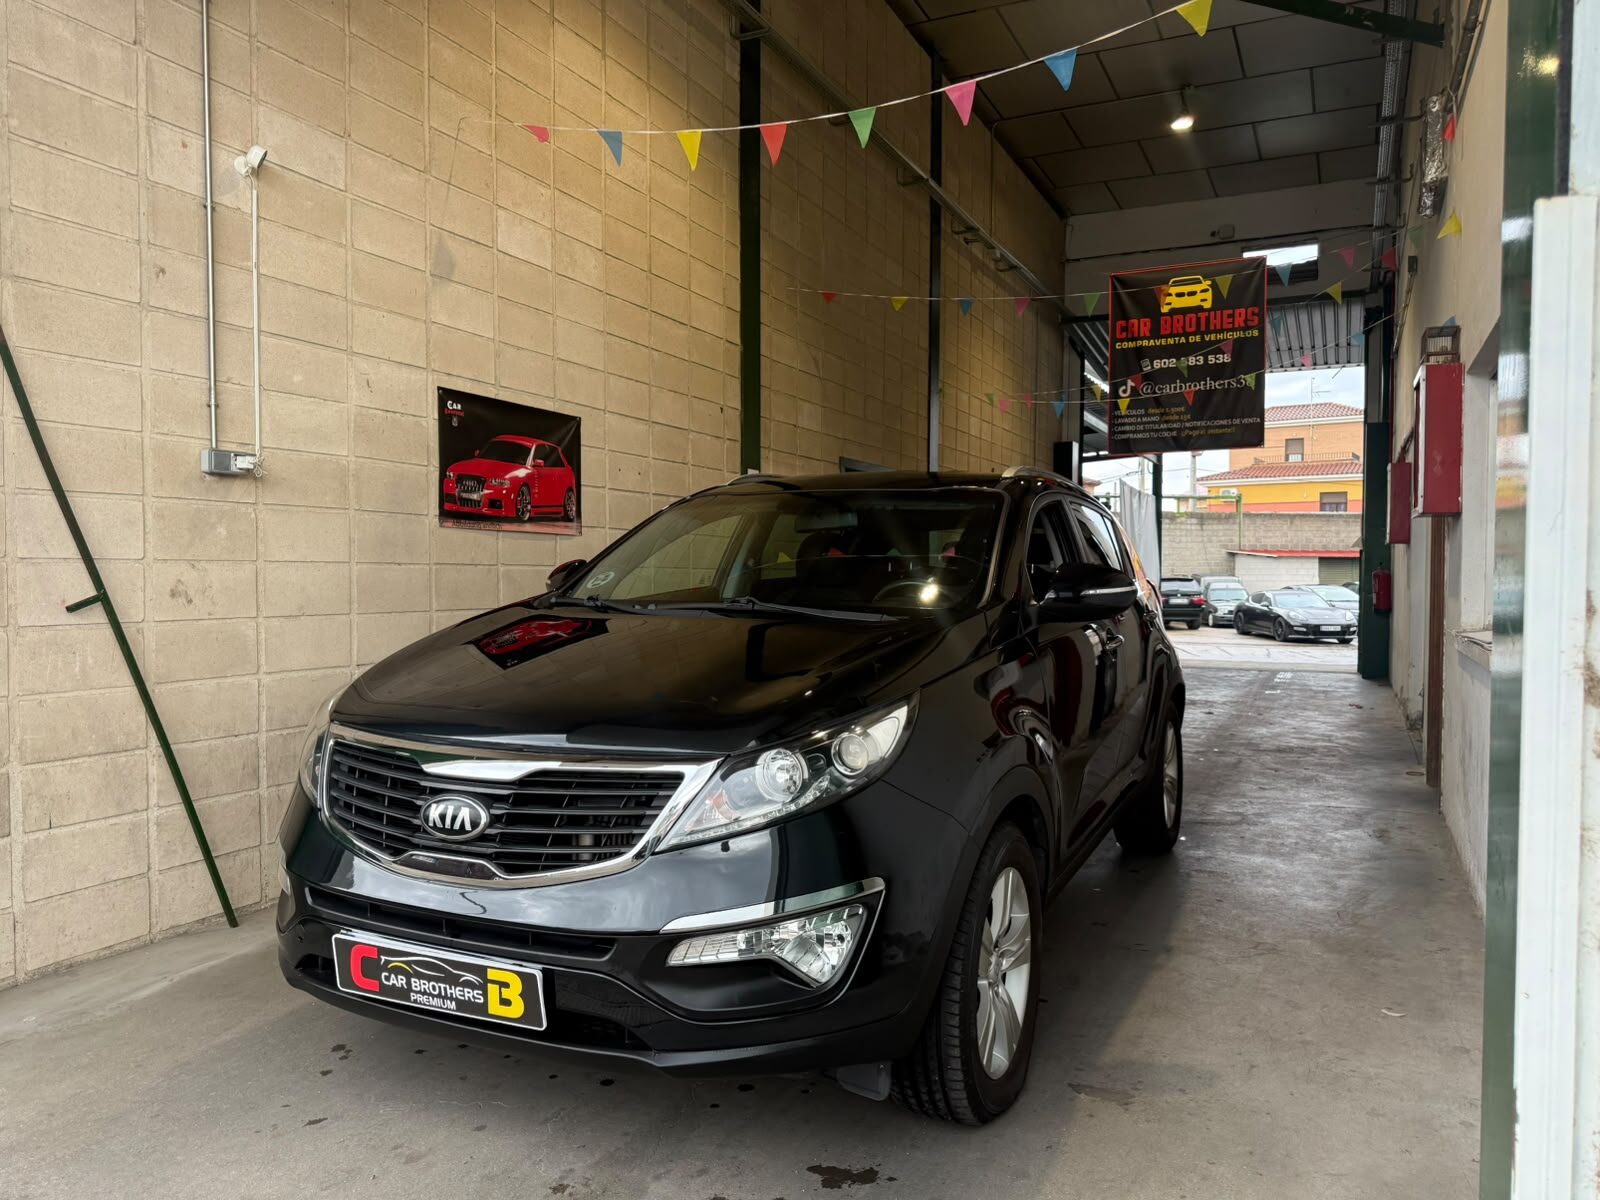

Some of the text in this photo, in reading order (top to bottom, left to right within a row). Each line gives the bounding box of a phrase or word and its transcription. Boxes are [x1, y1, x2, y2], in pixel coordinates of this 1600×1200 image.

[1115, 306, 1259, 339] CAR BROTHERS
[1115, 329, 1259, 350] COMPRAVENTA DE VEHÍCULOS
[1153, 358, 1177, 369] 602
[1207, 353, 1232, 364] 538
[1114, 408, 1145, 417] VECULOS
[1114, 416, 1137, 425] LAVADO
[1142, 415, 1160, 423] MANO
[1241, 417, 1261, 425] VENTA
[428, 803, 472, 831] KIA
[381, 971, 484, 1004] CAR BROTHERS
[410, 992, 457, 1011] PREMIUM
